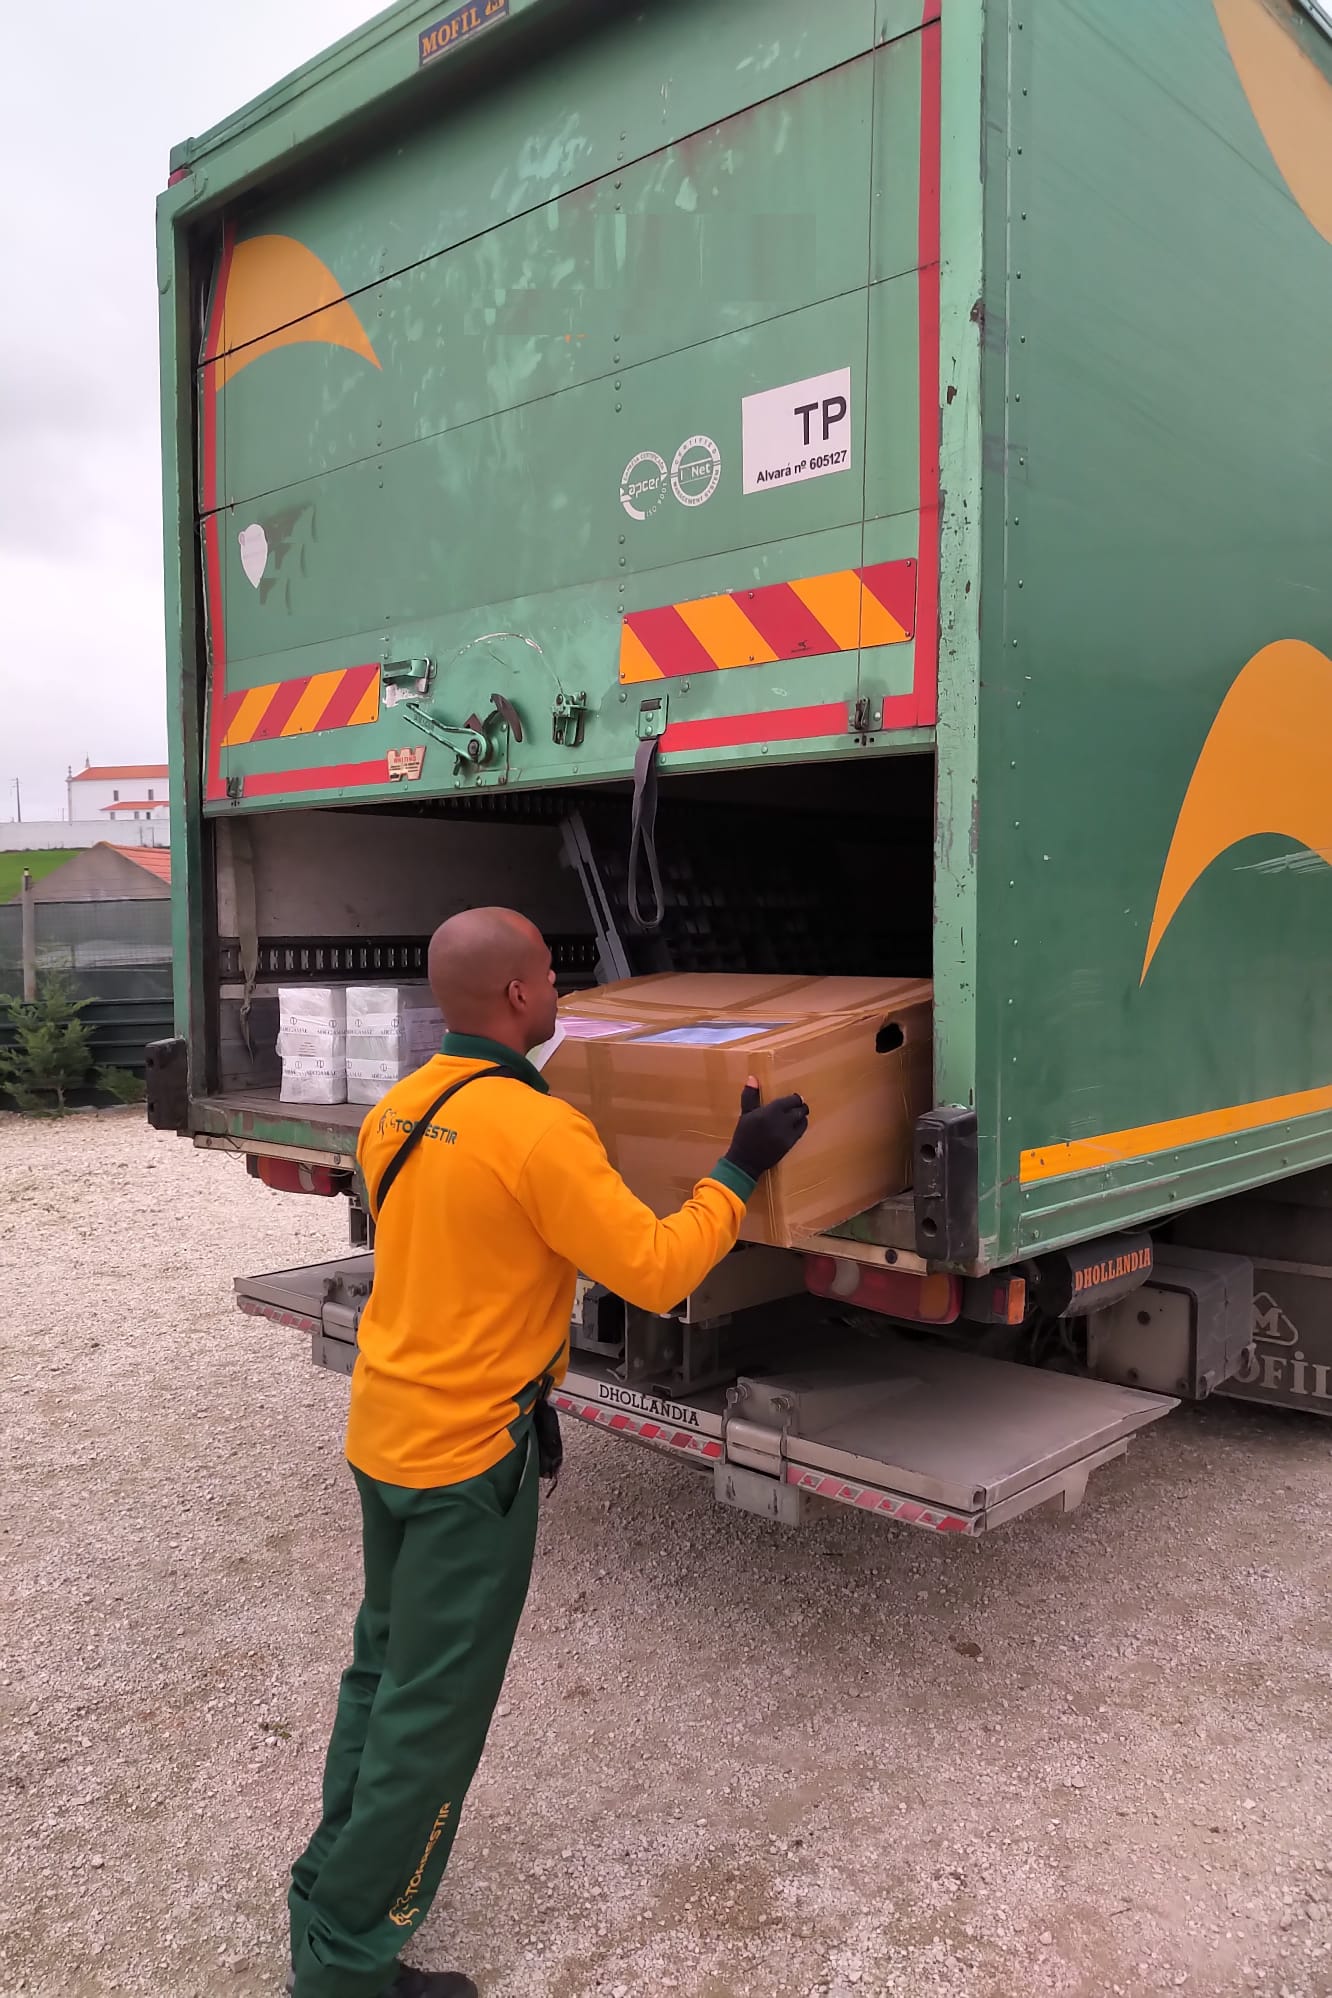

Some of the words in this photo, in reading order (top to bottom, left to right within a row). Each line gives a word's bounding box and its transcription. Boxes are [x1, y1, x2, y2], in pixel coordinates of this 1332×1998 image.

[422, 7, 481, 56] MOFIL
[794, 395, 847, 446] TP
[628, 477, 660, 499] apcer
[756, 462, 792, 484] Alvará
[809, 449, 847, 470] 605127
[395, 1118, 458, 1145] TOESTIR
[1075, 1247, 1151, 1292] DHOLLANDIA
[599, 1384, 700, 1427] DHOLLANDIA
